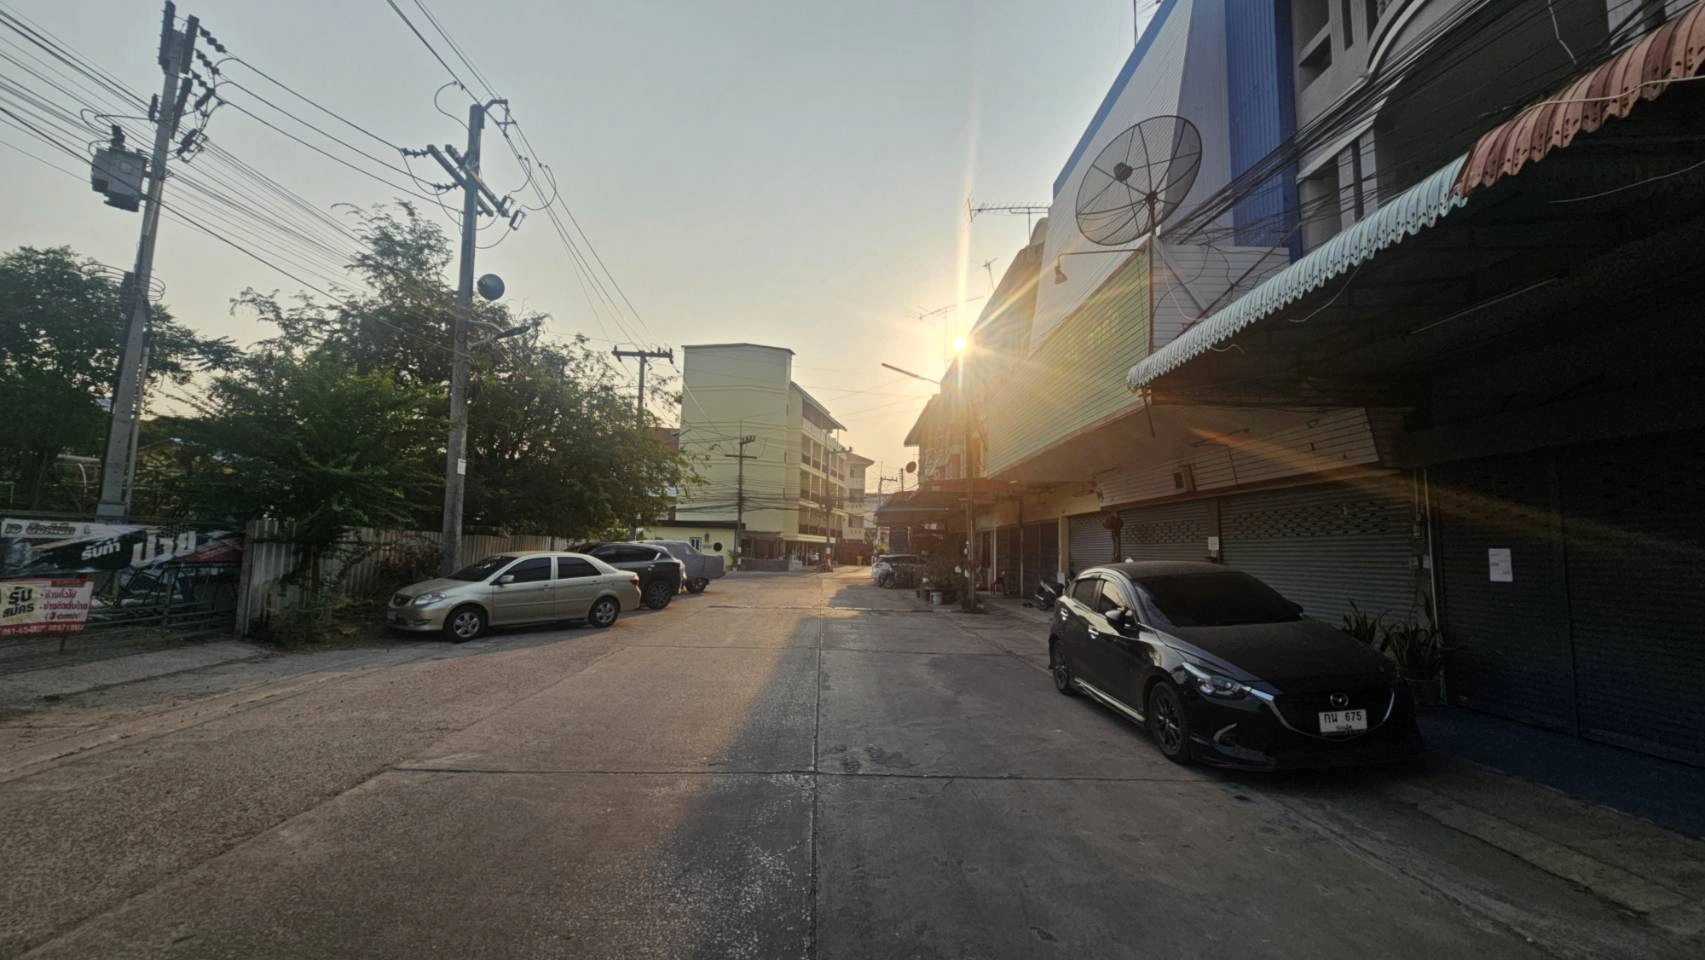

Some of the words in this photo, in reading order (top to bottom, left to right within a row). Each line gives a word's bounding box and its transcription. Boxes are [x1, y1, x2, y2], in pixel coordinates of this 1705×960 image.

[81, 537, 121, 561] รับทำ
[8, 586, 33, 605] รับ
[2, 602, 35, 618] สมัคร
[1345, 711, 1362, 722] 675
